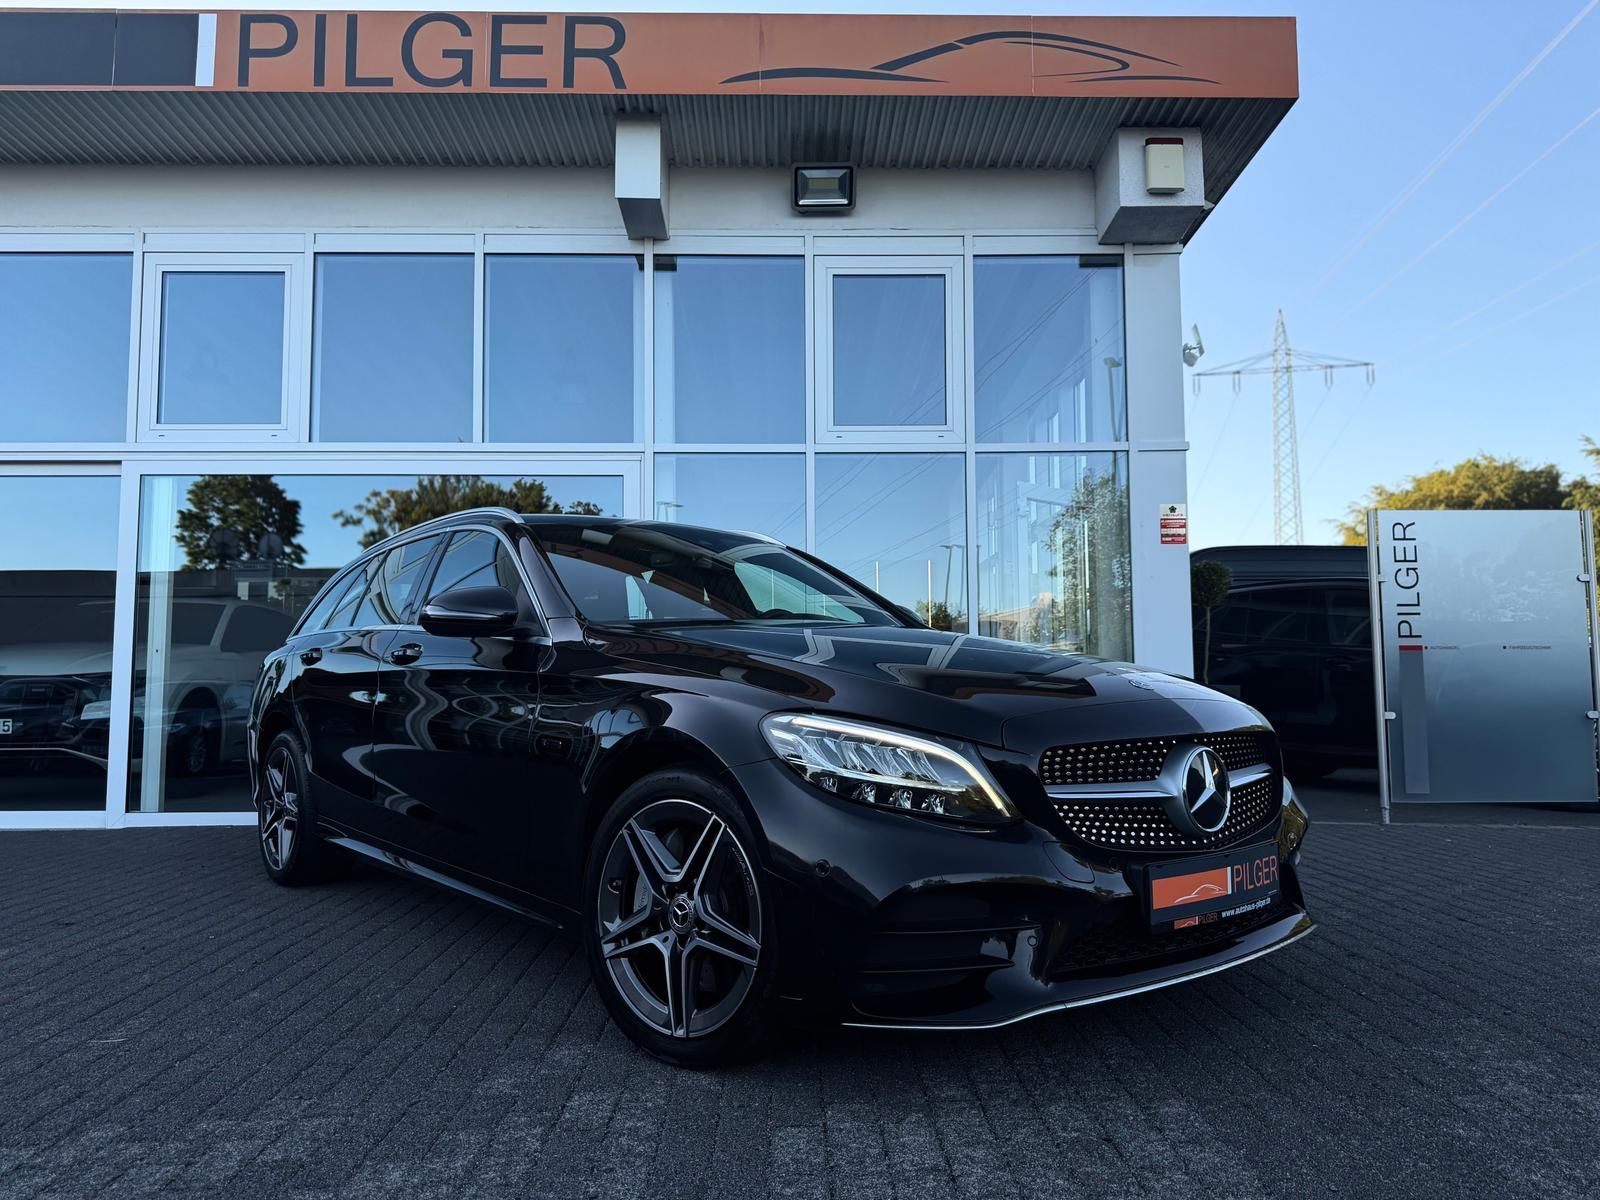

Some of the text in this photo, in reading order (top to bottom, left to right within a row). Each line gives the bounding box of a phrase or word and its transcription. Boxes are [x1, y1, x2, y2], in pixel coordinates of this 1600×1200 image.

[237, 12, 627, 90] PILGER
[1392, 521, 1422, 639] PILGER
[1233, 855, 1278, 894] PILGER
[1198, 912, 1218, 924] PILGER
